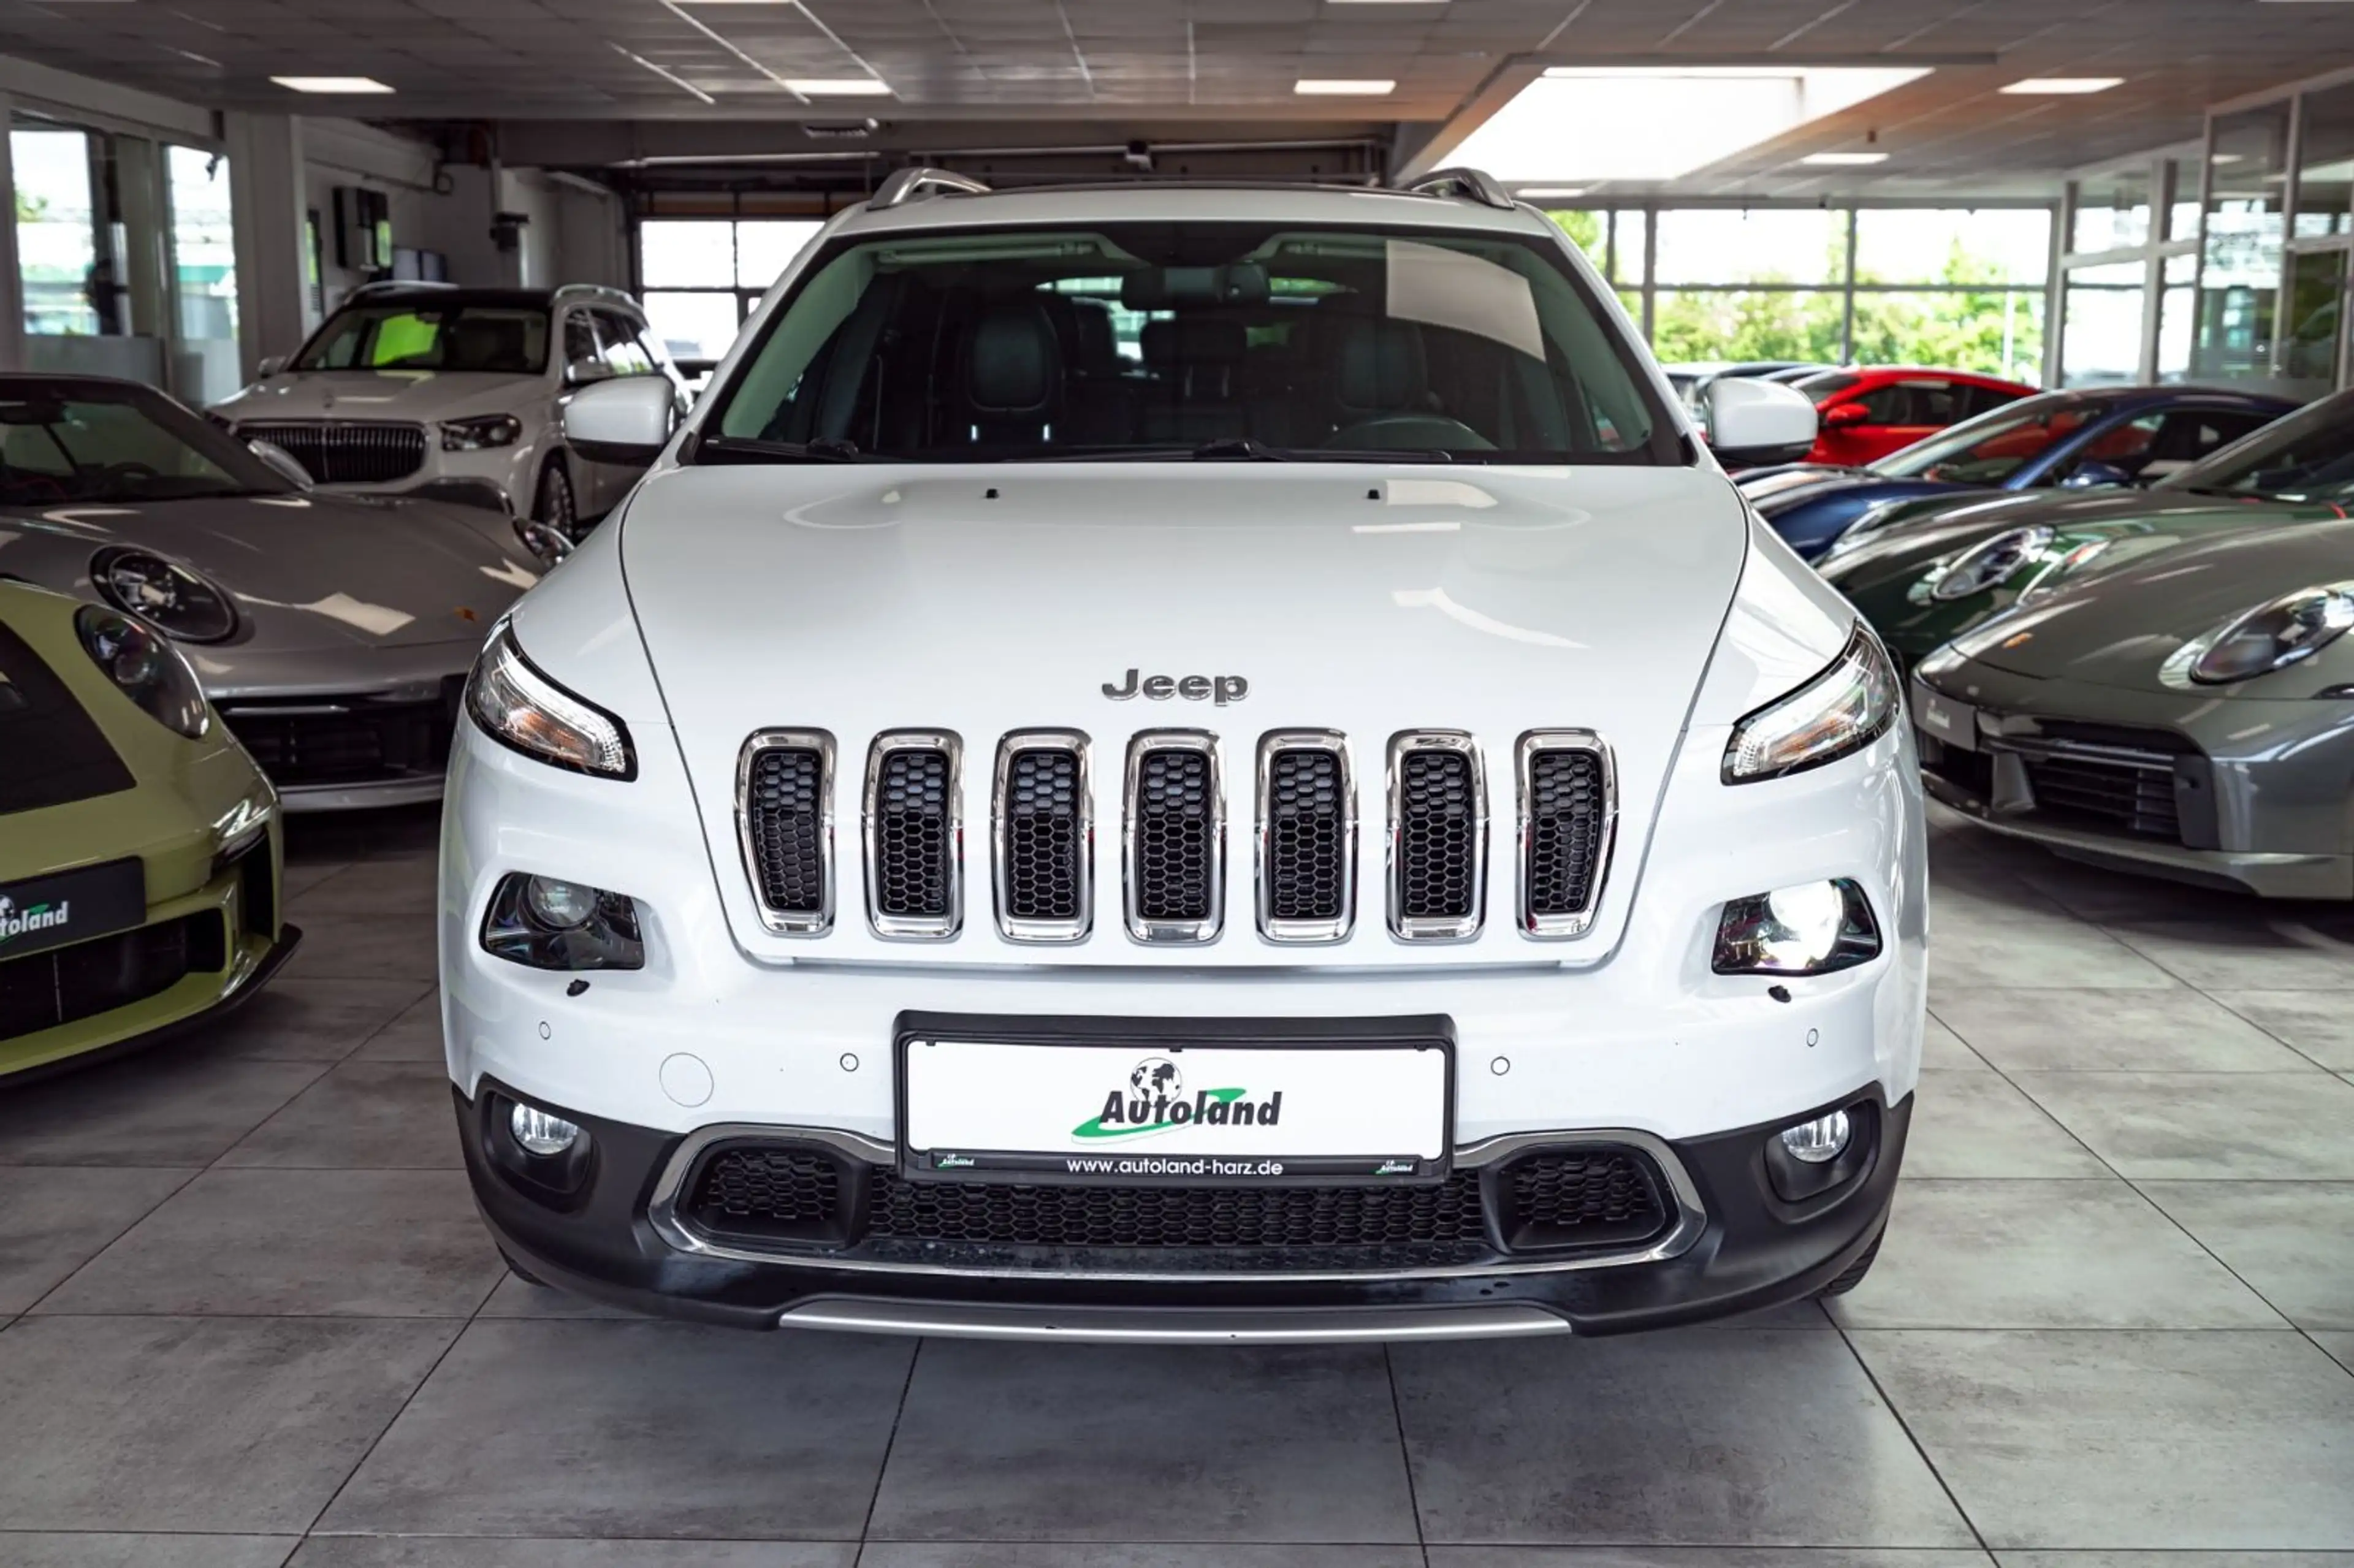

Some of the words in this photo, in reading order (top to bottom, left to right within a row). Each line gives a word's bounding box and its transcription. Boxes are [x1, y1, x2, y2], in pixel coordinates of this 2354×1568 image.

[1102, 669, 1250, 706] Jeep
[1099, 1090, 1282, 1125] Autoland
[1067, 1158, 1284, 1175] www.autoland-harz.de
